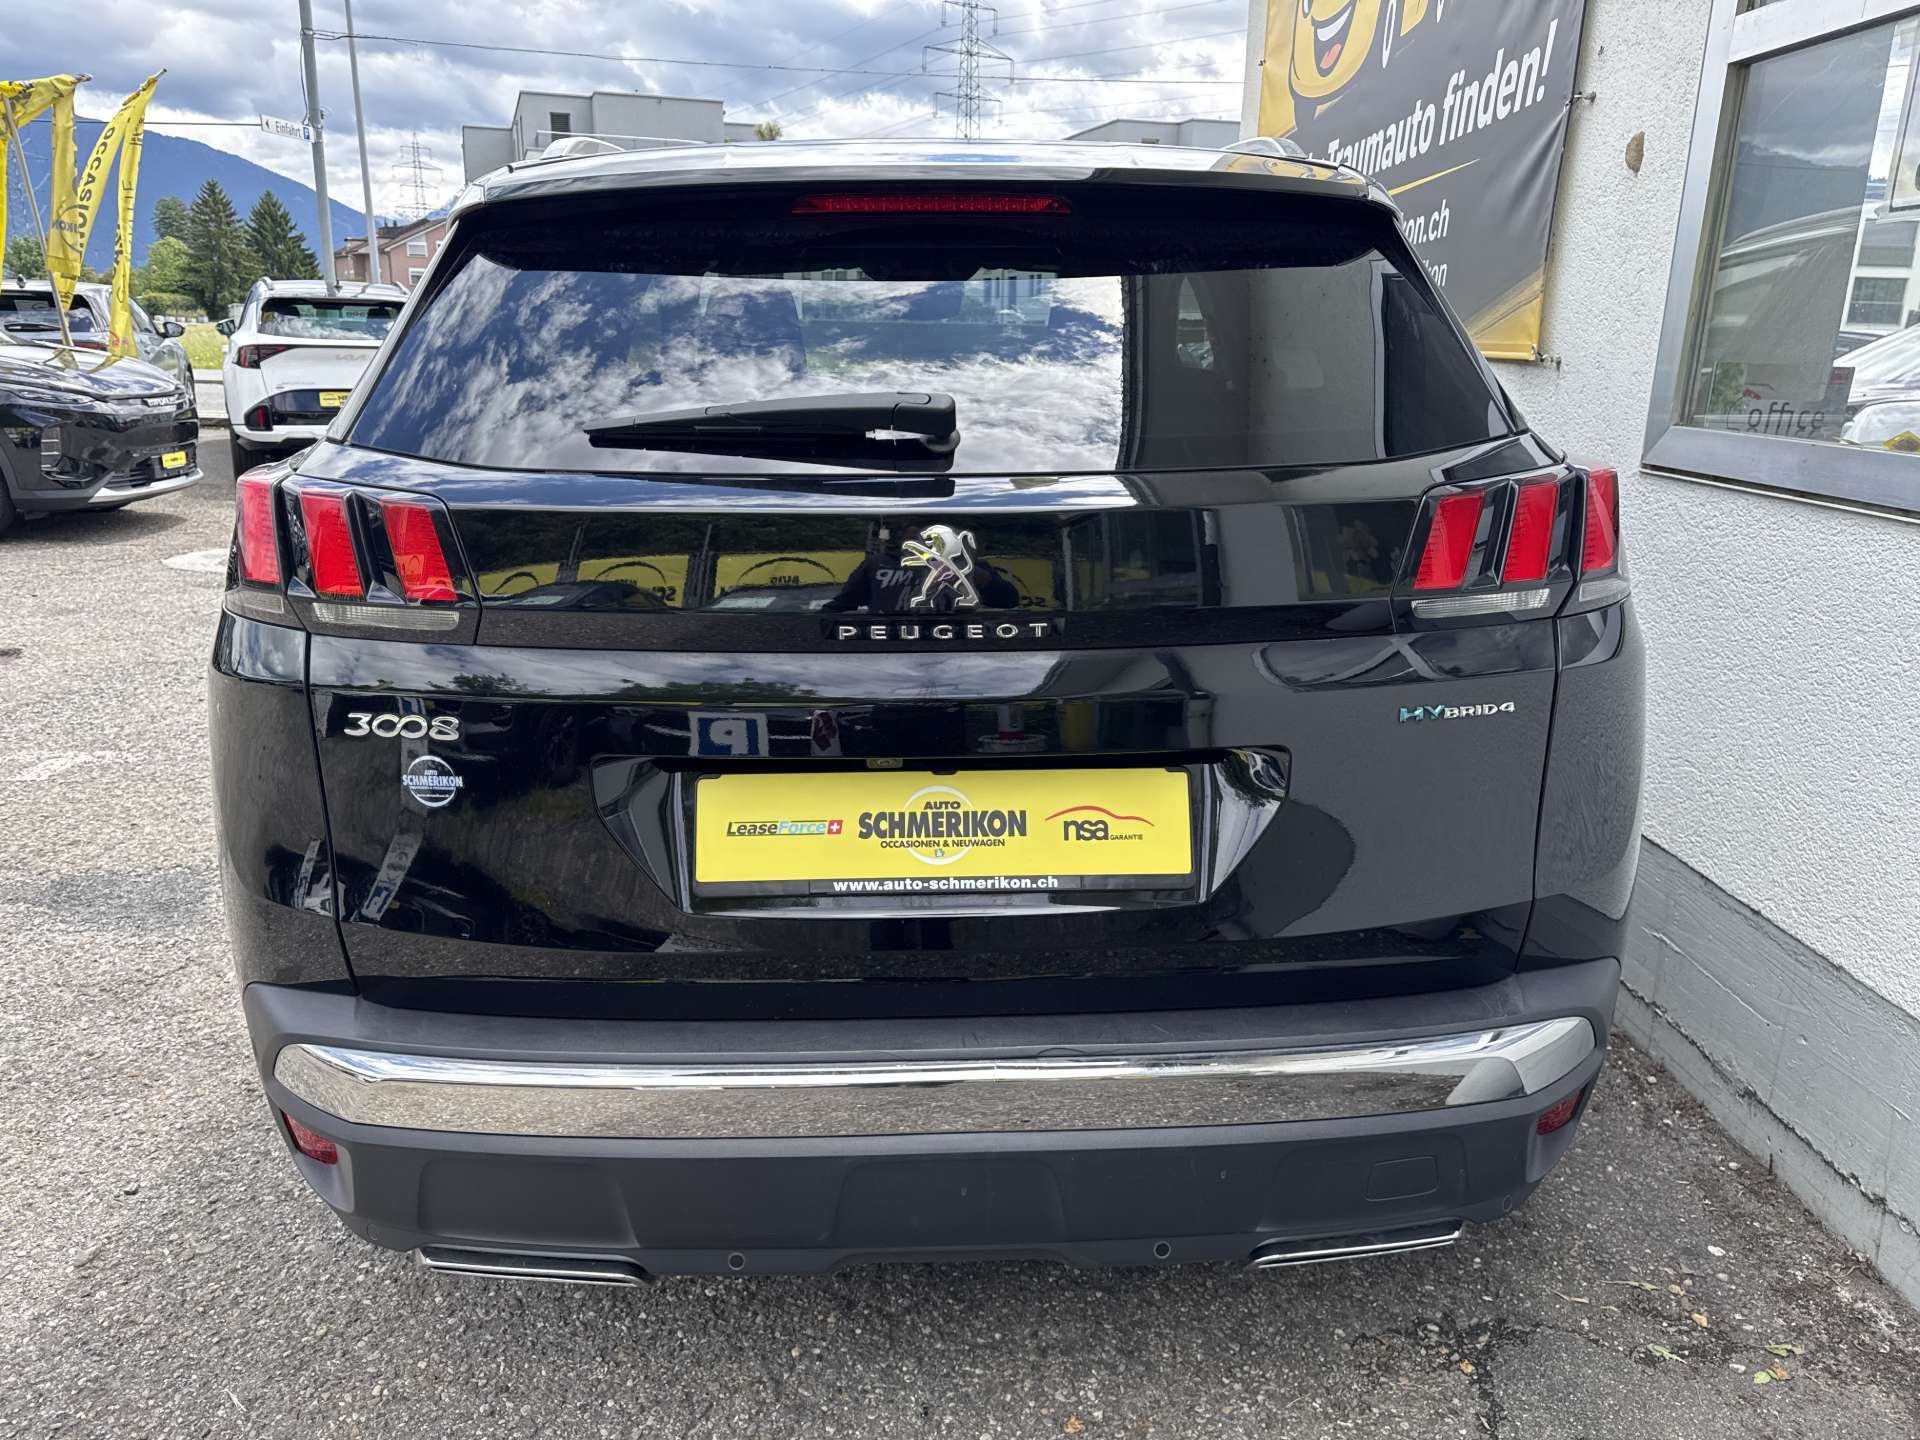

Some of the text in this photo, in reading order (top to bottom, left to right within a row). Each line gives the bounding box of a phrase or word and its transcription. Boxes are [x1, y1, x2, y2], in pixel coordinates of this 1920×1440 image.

[1438, 18, 1559, 146] finden!
[1747, 401, 1825, 434] office
[838, 622, 1048, 641] PEUGEOT
[1399, 701, 1516, 722] HYBRID4
[344, 712, 460, 741] 3008
[402, 775, 463, 788] SCHMERIKON
[923, 801, 961, 810] AUTO
[727, 820, 827, 836] LeaseForce
[858, 810, 1027, 839] SCHMERIKON
[1063, 820, 1109, 841] nsa
[880, 839, 1005, 849] OCCASIONEN & NEUWAGEN
[833, 876, 1059, 891] www.auto-schmerikon.ch
